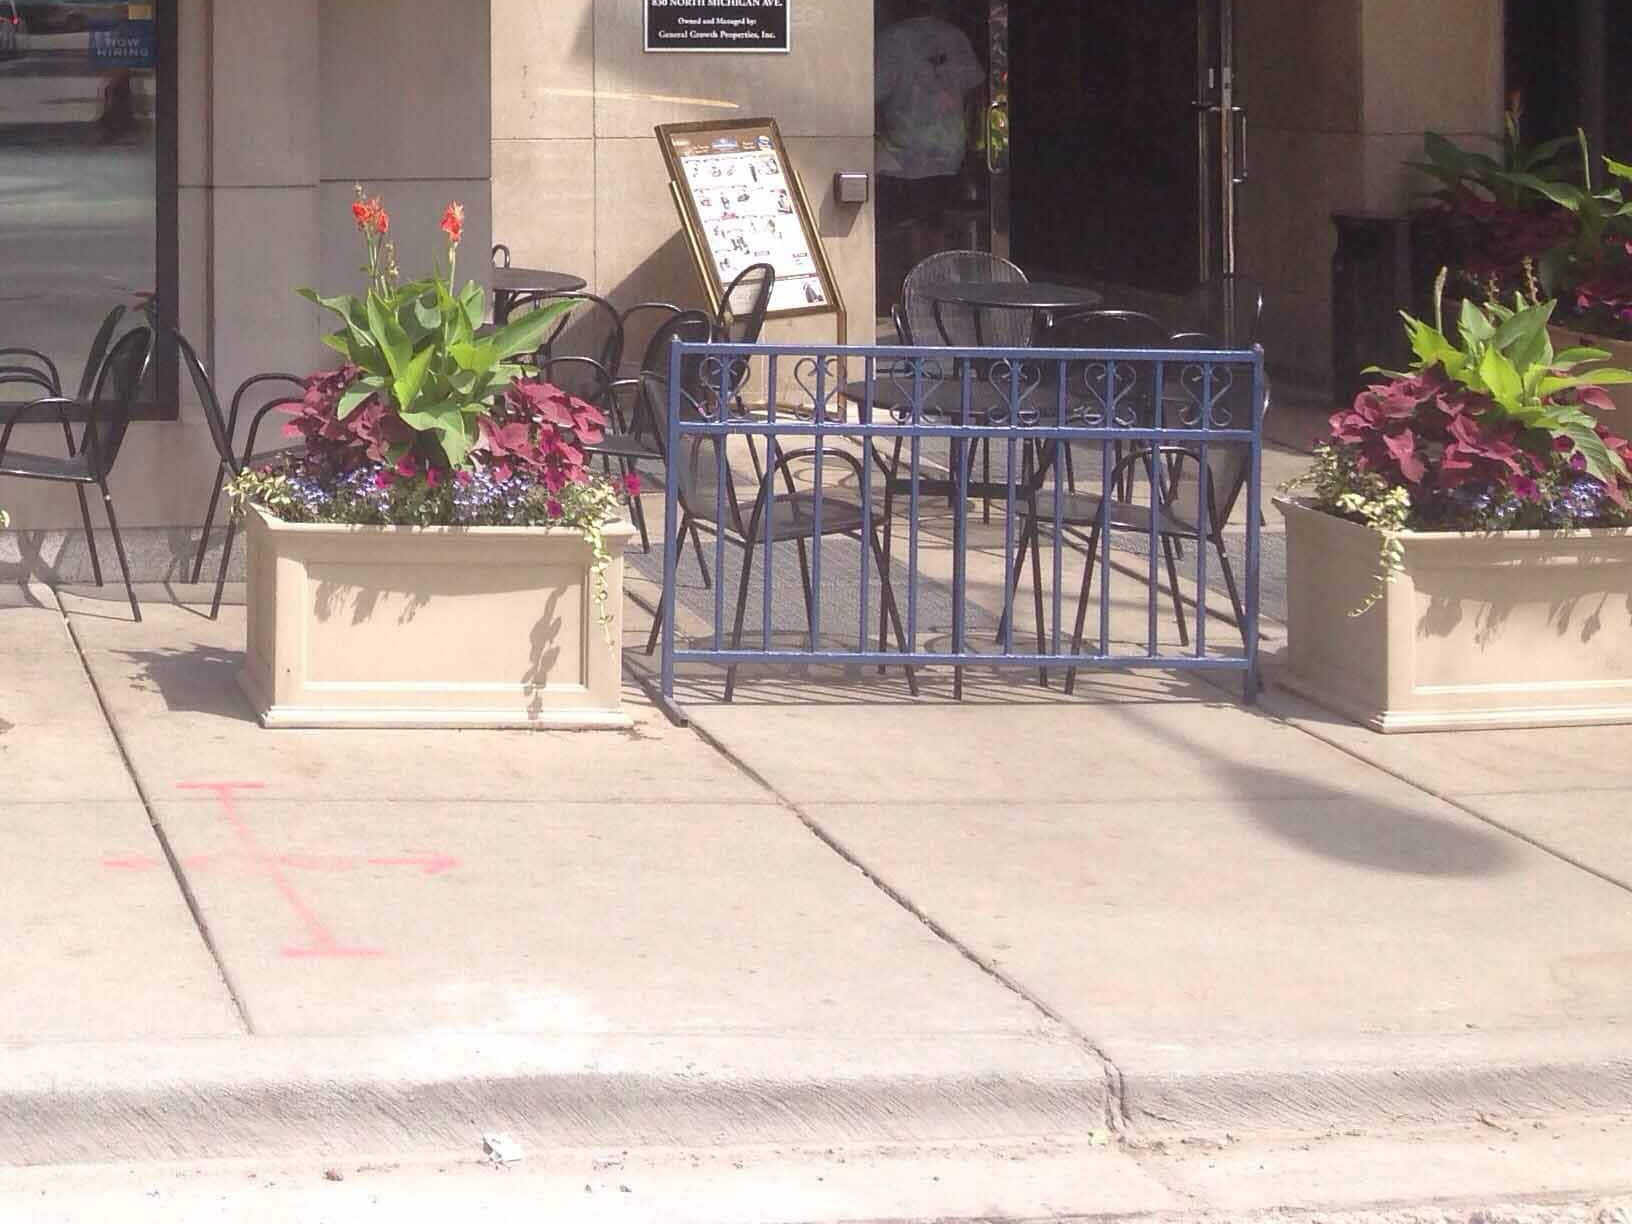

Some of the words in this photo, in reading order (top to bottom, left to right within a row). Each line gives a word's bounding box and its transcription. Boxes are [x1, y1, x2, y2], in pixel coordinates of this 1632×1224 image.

[678, 17, 701, 25] Owned
[702, 17, 715, 25] and
[716, 17, 745, 26] Managed
[658, 30, 688, 39] General
[689, 30, 718, 39] Growth
[720, 30, 760, 40] Properties,
[761, 30, 776, 39] Inc.
